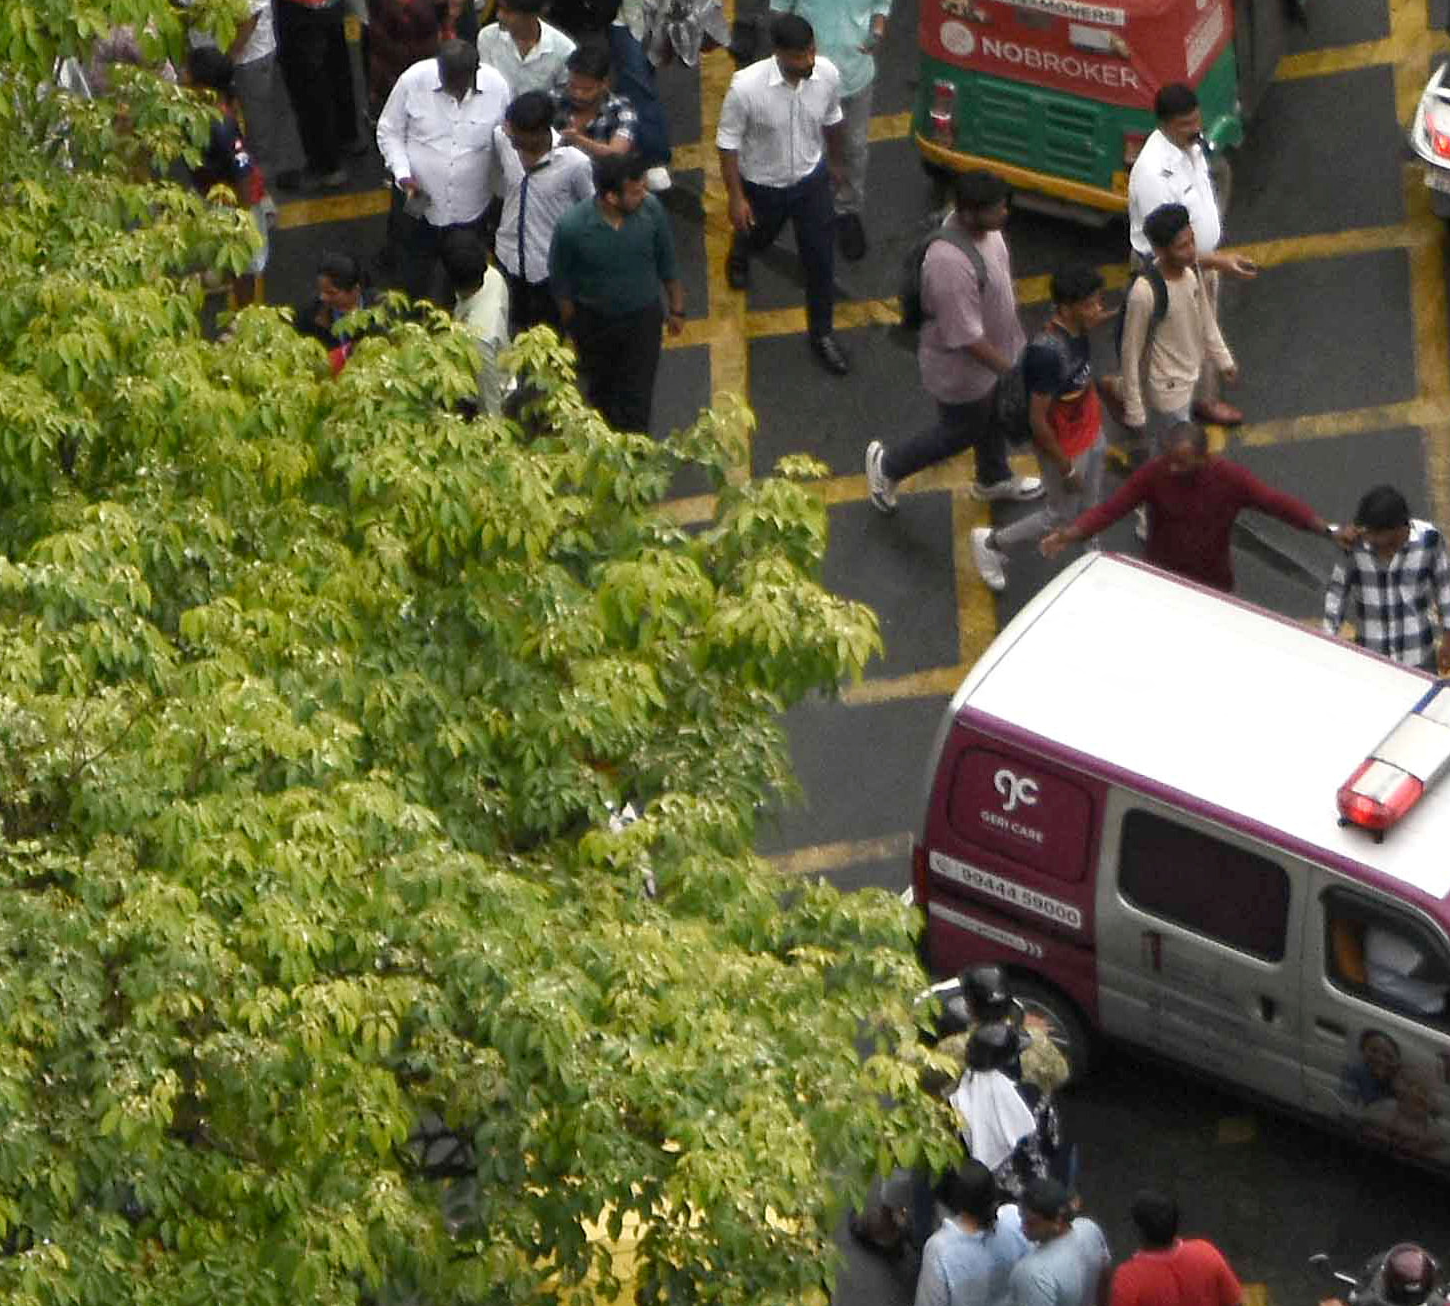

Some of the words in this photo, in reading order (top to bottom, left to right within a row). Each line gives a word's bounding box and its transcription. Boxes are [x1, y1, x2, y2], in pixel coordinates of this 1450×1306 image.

[980, 35, 1140, 89] NOBROKER
[980, 810, 1010, 830] GERI
[1011, 822, 1044, 844] CARE
